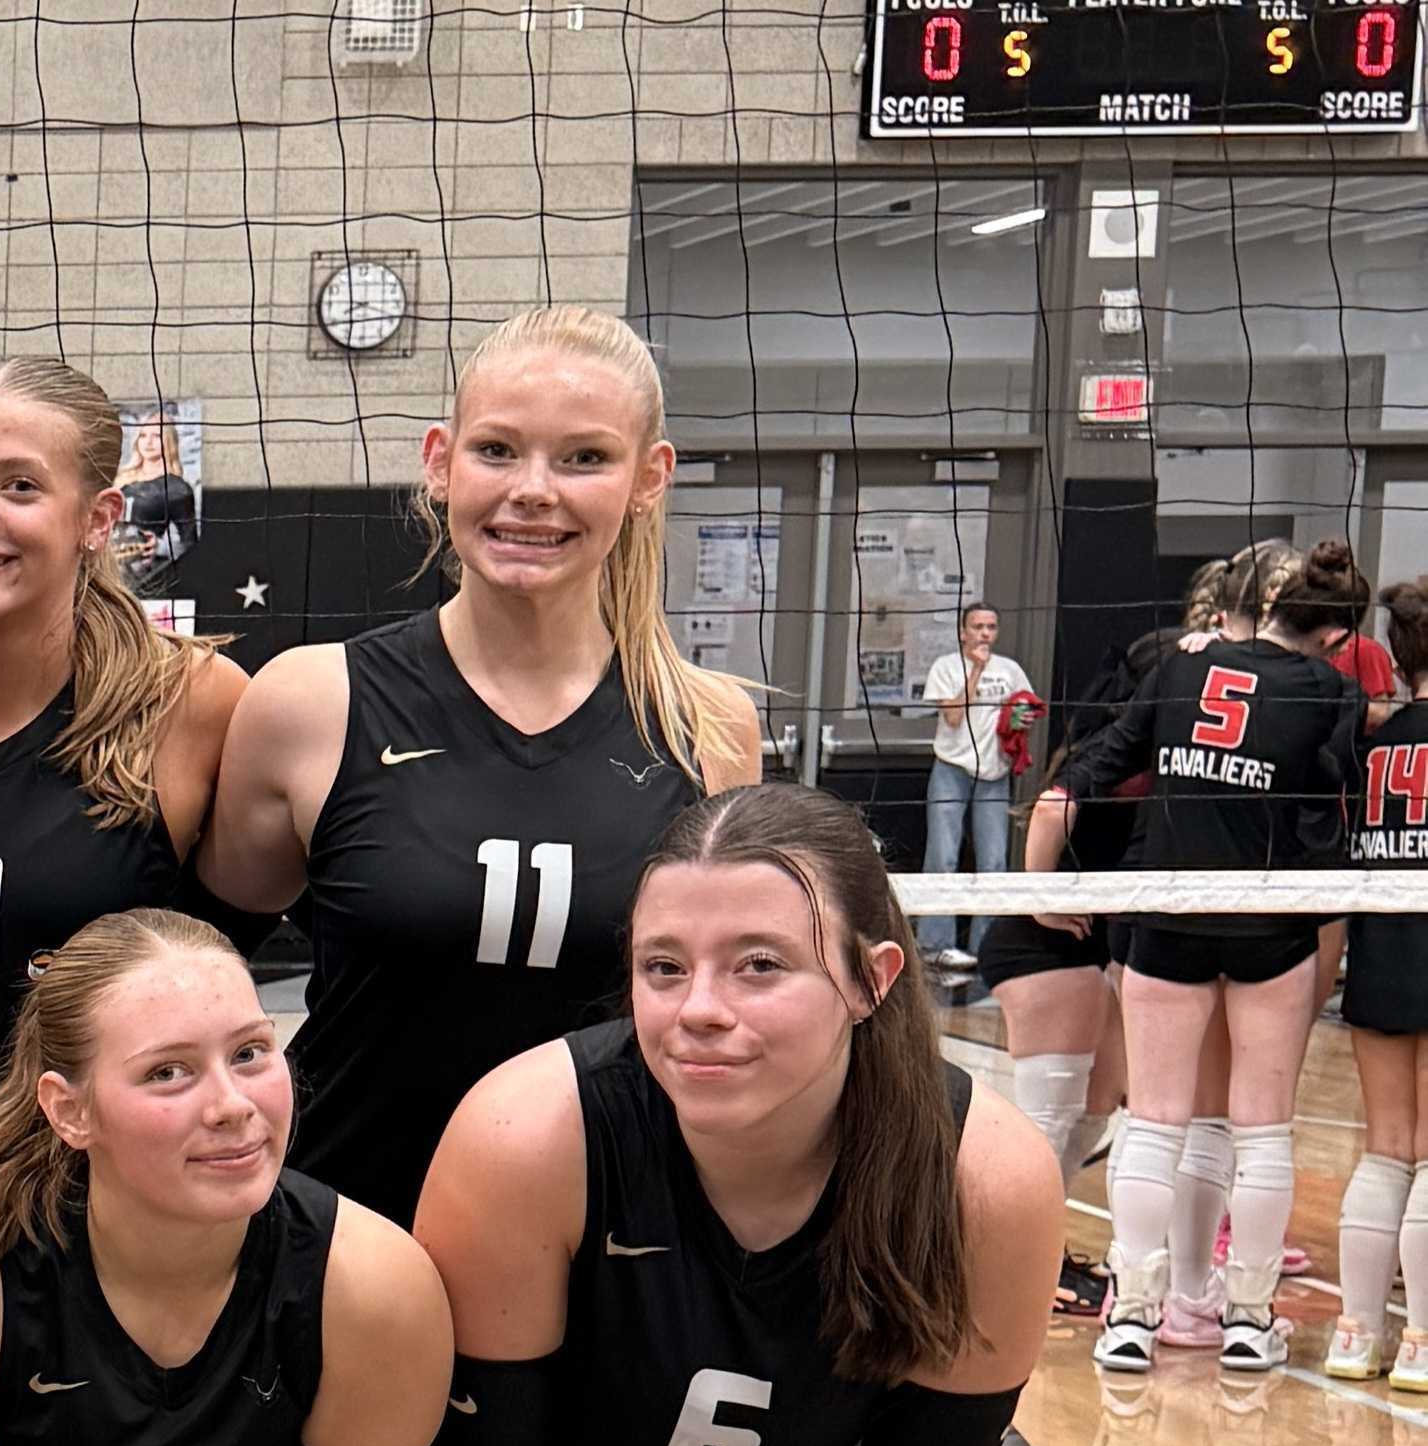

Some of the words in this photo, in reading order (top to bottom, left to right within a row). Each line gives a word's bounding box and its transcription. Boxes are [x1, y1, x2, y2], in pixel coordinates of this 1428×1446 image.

[999, 4, 1048, 23] T.O.L.
[1258, 1, 1307, 20] T.O.L.
[924, 17, 961, 80] 0
[1003, 30, 1031, 77] 5
[1266, 27, 1293, 74] 5
[1356, 12, 1395, 77] 0
[881, 96, 965, 123] SCORE
[1099, 94, 1191, 121] MATCH
[1321, 91, 1404, 119] SCORE
[1192, 665, 1258, 750] 5
[1158, 747, 1276, 791] CAVALIERS
[1366, 743, 1428, 827] 14
[476, 839, 573, 968] 11
